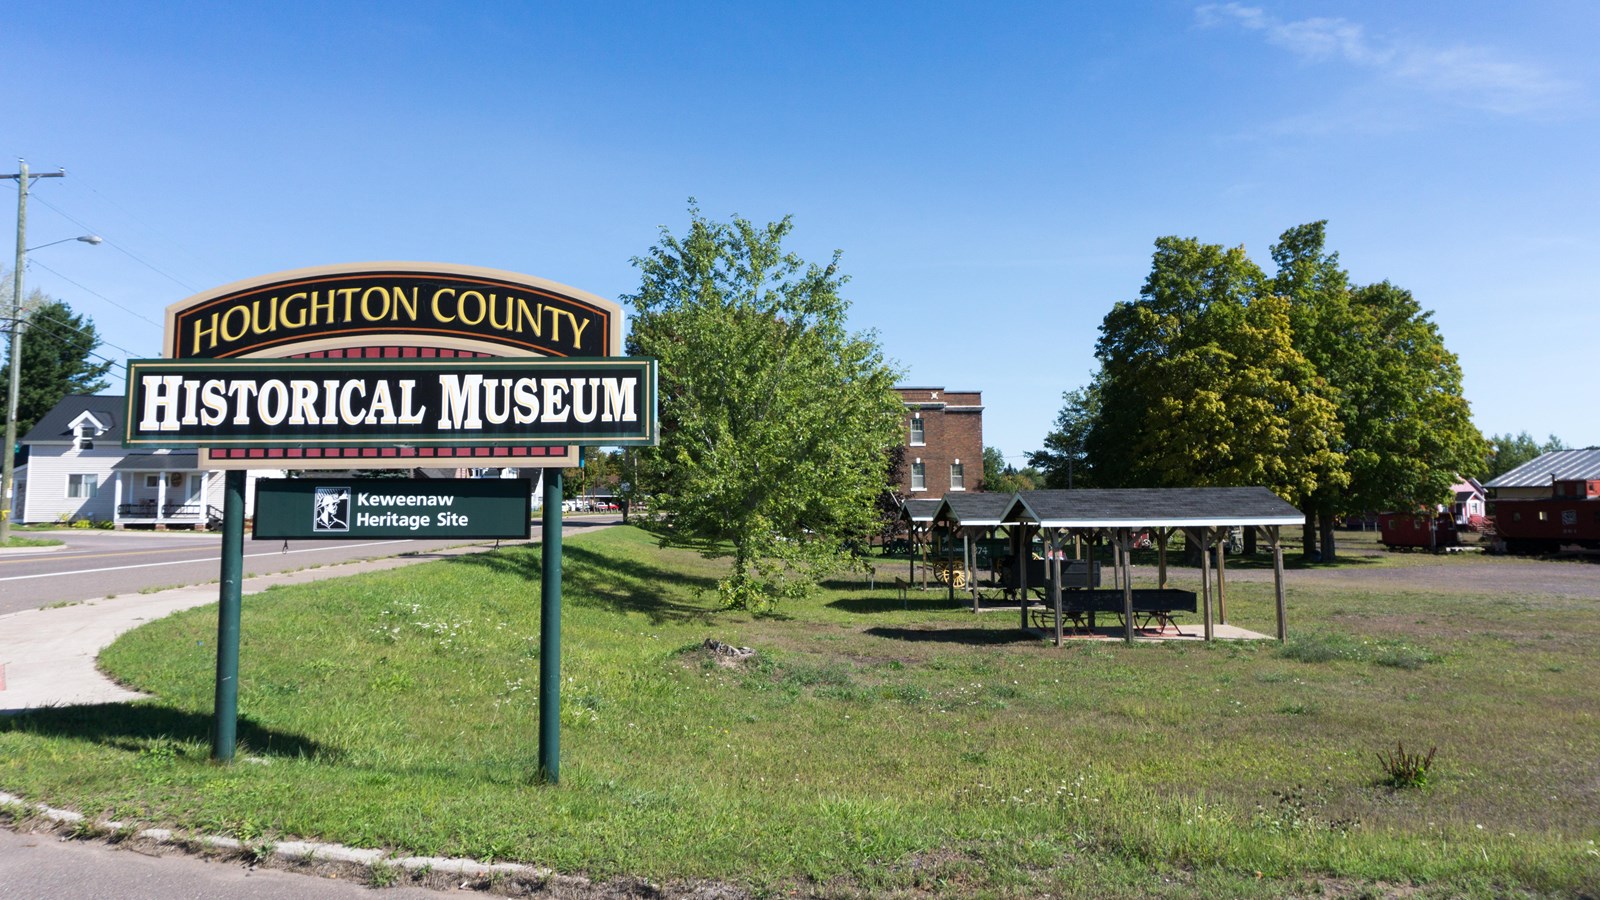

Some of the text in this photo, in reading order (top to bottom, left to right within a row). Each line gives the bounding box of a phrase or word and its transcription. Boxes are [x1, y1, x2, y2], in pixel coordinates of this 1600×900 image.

[192, 286, 590, 355] HOUGHTON COUNTY
[139, 374, 637, 431] HISTORICAL MUSEUM
[357, 492, 454, 507] Keweenaw
[356, 511, 469, 531] Heritage Site
